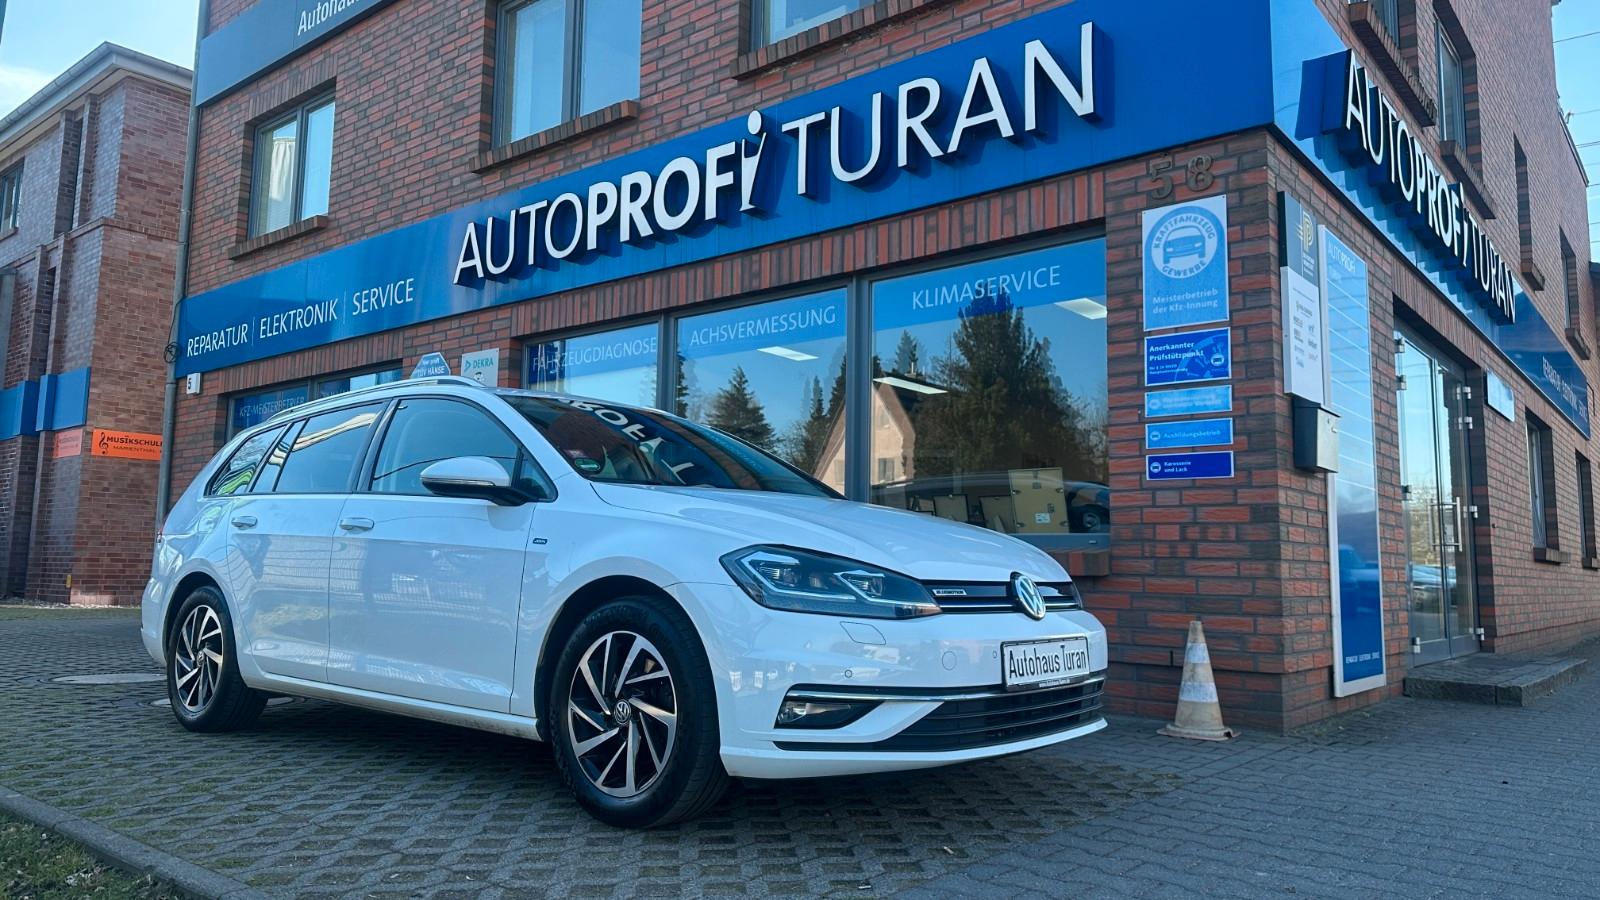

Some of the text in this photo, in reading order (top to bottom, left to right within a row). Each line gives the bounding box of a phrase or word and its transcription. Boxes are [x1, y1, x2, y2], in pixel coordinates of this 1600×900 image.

[781, 22, 1095, 196] TURAN
[1150, 154, 1214, 199] 58
[1153, 214, 1216, 249] KRAFTFAHRZEUG
[1468, 213, 1516, 324] TURAN
[911, 265, 1061, 311] KLIMASERVICE
[1152, 287, 1219, 305] Meisterbetrieb
[187, 278, 414, 358] REPARATUR ELEKTRONIK SERVICE
[1152, 299, 1218, 314] der Kfz-Innung
[690, 305, 836, 346] ACHSVERMESSUNG
[472, 357, 494, 369] DEKRA
[532, 336, 657, 372] FAHRZEUGDIAGNOSE
[1149, 342, 1195, 353] Anerkannter
[1149, 350, 1205, 363] Prüfstützpunkt
[1009, 643, 1087, 679] Autohaus Turan
